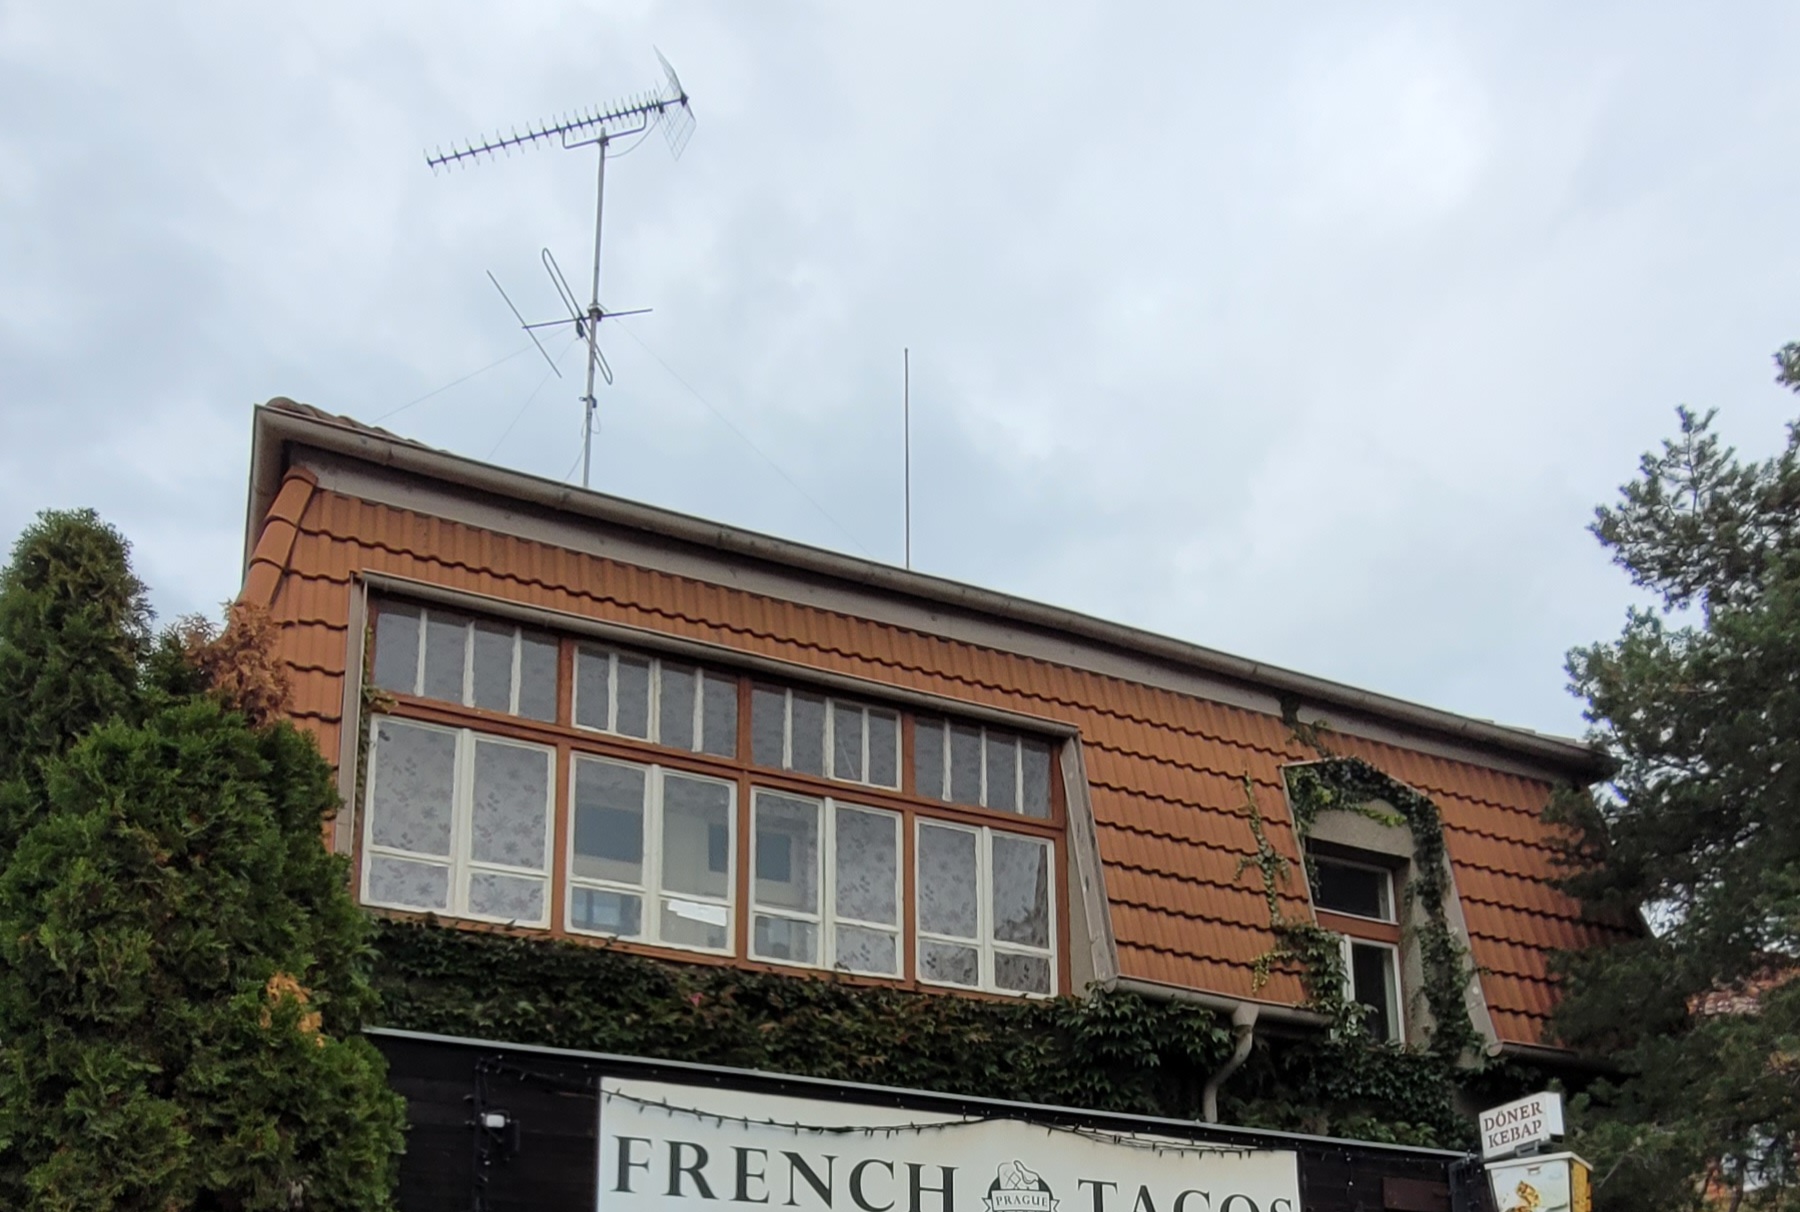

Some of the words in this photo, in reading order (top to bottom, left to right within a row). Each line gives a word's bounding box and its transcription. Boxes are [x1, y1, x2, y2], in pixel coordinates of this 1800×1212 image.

[1484, 1101, 1543, 1132] DÖNER
[1488, 1119, 1542, 1149] KEBAP
[995, 1194, 1048, 1208] PRAGUE
